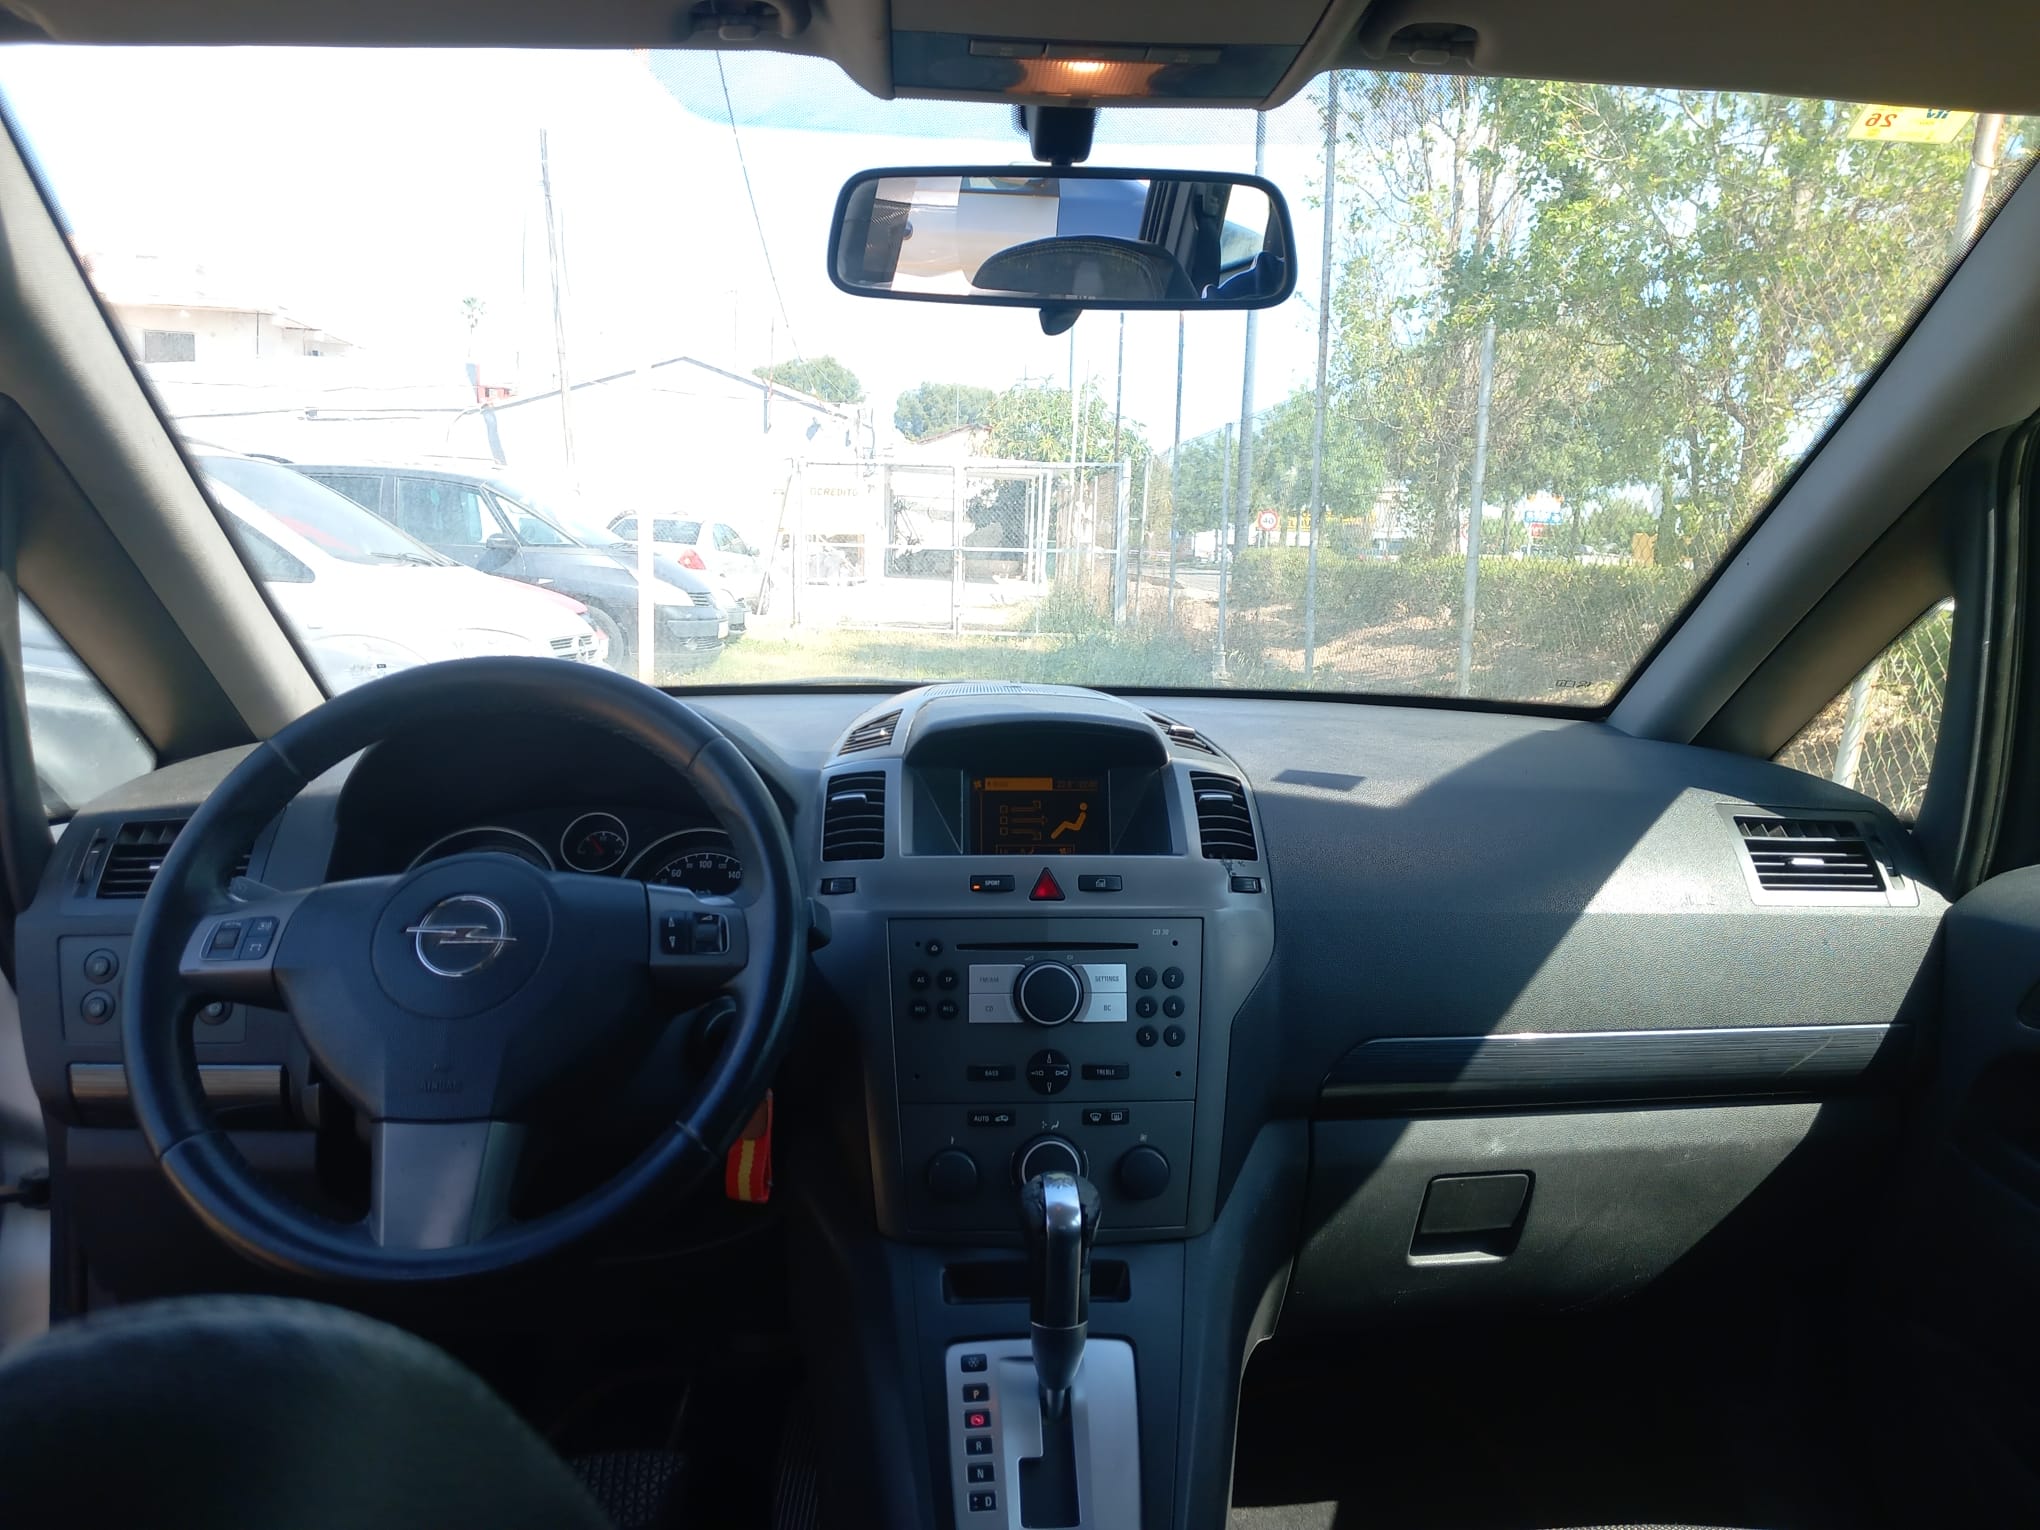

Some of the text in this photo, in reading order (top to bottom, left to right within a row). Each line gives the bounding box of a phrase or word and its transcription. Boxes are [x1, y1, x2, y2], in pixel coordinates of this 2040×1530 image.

[1262, 516, 1275, 525] 40
[700, 860, 713, 869] 100
[671, 869, 682, 878] 60
[728, 871, 741, 879] 140
[1095, 974, 1120, 983] SETTINGS
[1096, 1068, 1115, 1076] TREBLE
[973, 1114, 989, 1123] AUTO
[973, 1389, 980, 1400] P
[976, 1441, 982, 1451] R
[977, 1468, 984, 1479] N
[985, 1496, 992, 1507] D
